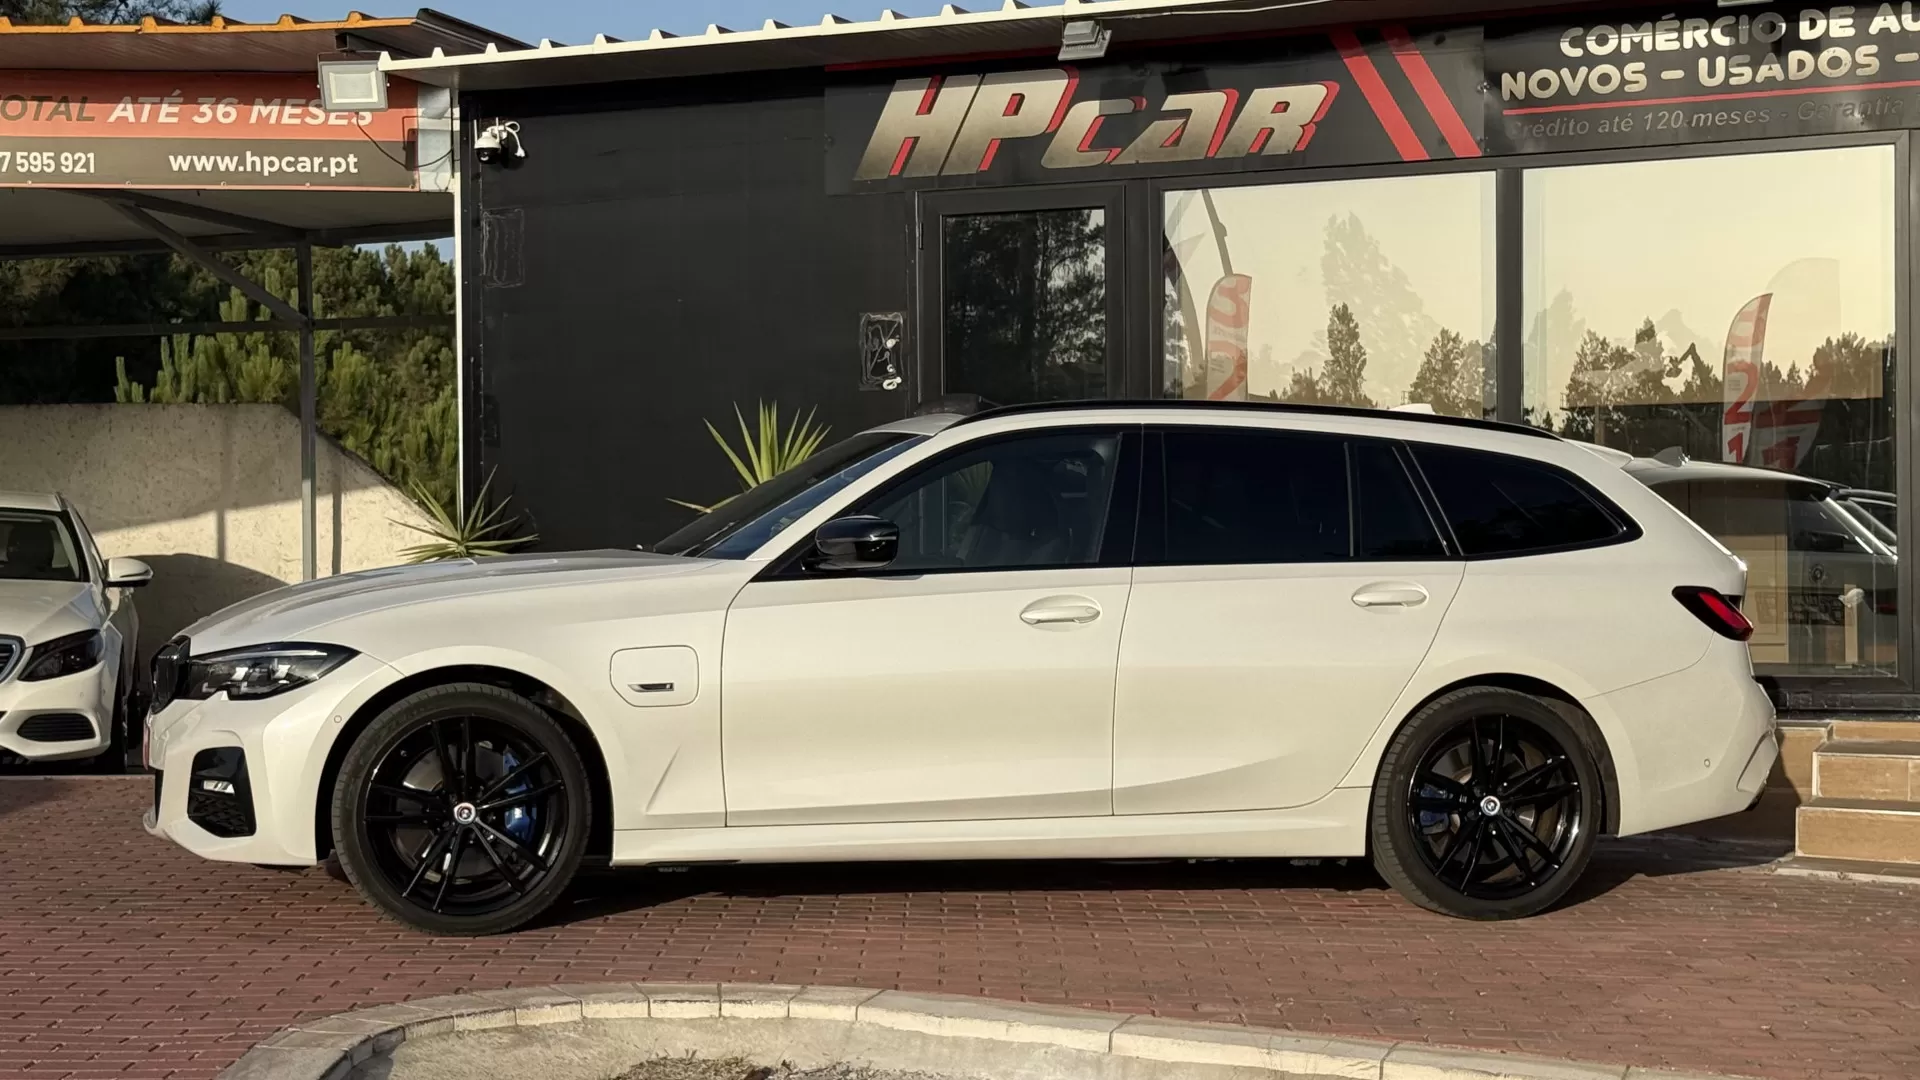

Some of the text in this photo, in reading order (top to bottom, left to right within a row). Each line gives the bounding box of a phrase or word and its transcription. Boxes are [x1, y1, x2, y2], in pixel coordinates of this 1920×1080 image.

[1559, 12, 1786, 58] COMÉRCIO
[1799, 6, 1856, 40] DE
[1501, 61, 1648, 101] NOVOS
[1698, 44, 1880, 87] USADOS
[0, 94, 95, 121] OTAL
[107, 89, 184, 123] ATÉ
[191, 97, 239, 124] 36
[1597, 113, 1634, 133] até
[1644, 110, 1684, 131] 120
[1691, 107, 1771, 128] meses
[16, 151, 56, 173] 595
[60, 152, 95, 174] 921
[168, 150, 359, 177] www.hpcar.pt
